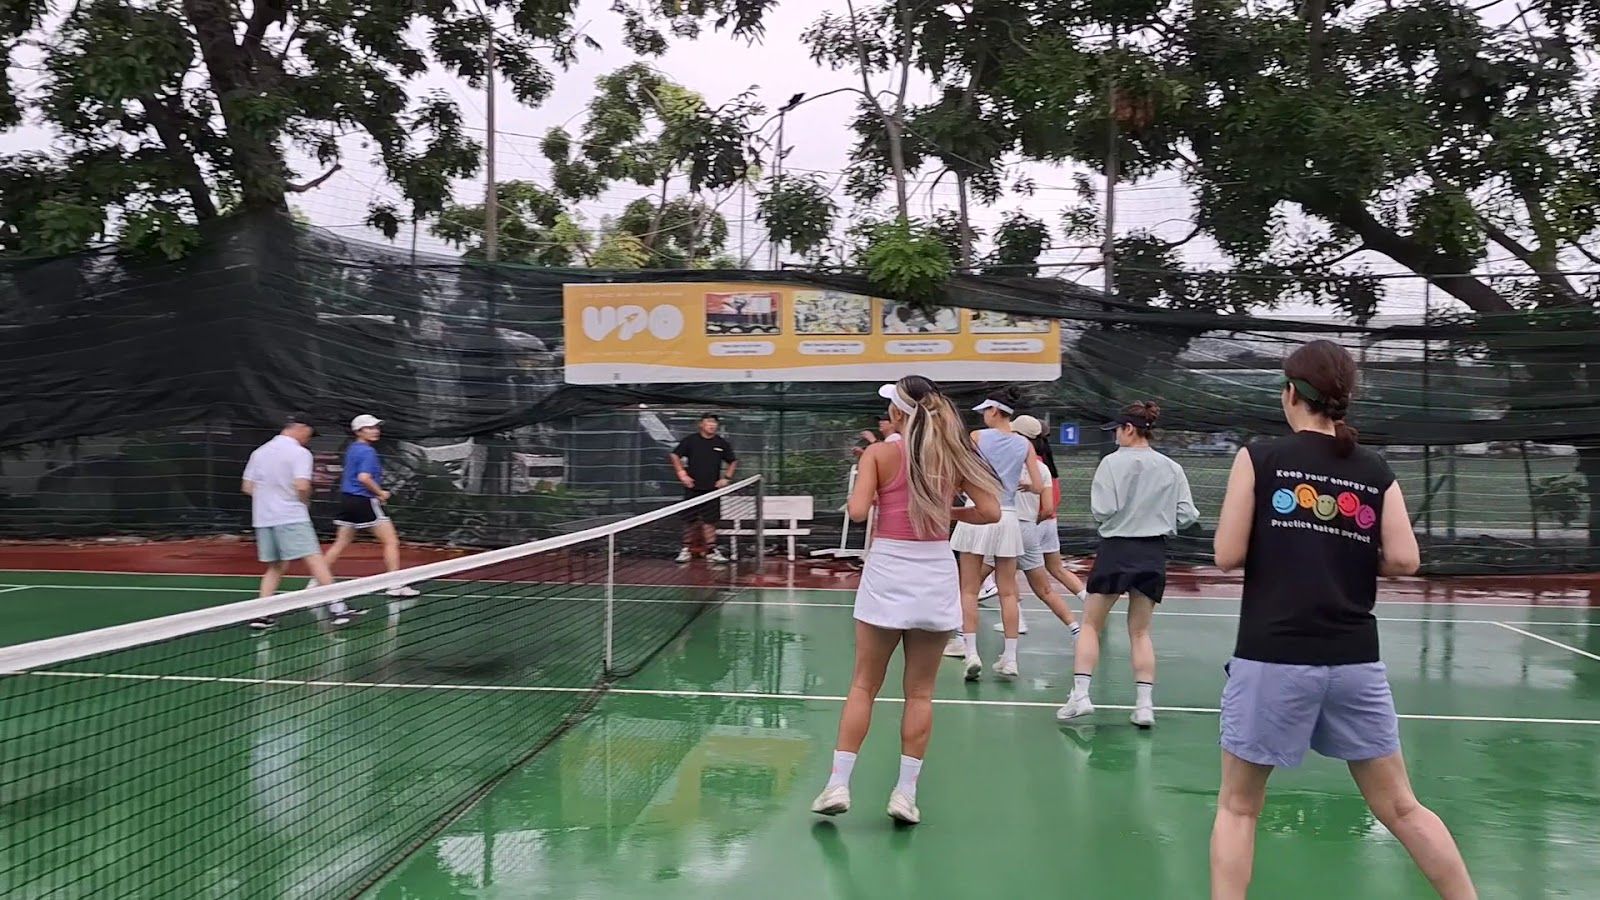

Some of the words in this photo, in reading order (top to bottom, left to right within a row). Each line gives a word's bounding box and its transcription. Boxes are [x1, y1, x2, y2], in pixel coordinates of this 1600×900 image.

[1065, 426, 1075, 440] 1
[1276, 469, 1303, 479] Keep
[1305, 472, 1328, 482] your
[1330, 477, 1366, 491] energy
[1366, 485, 1379, 495] up
[1271, 519, 1311, 529] Practice
